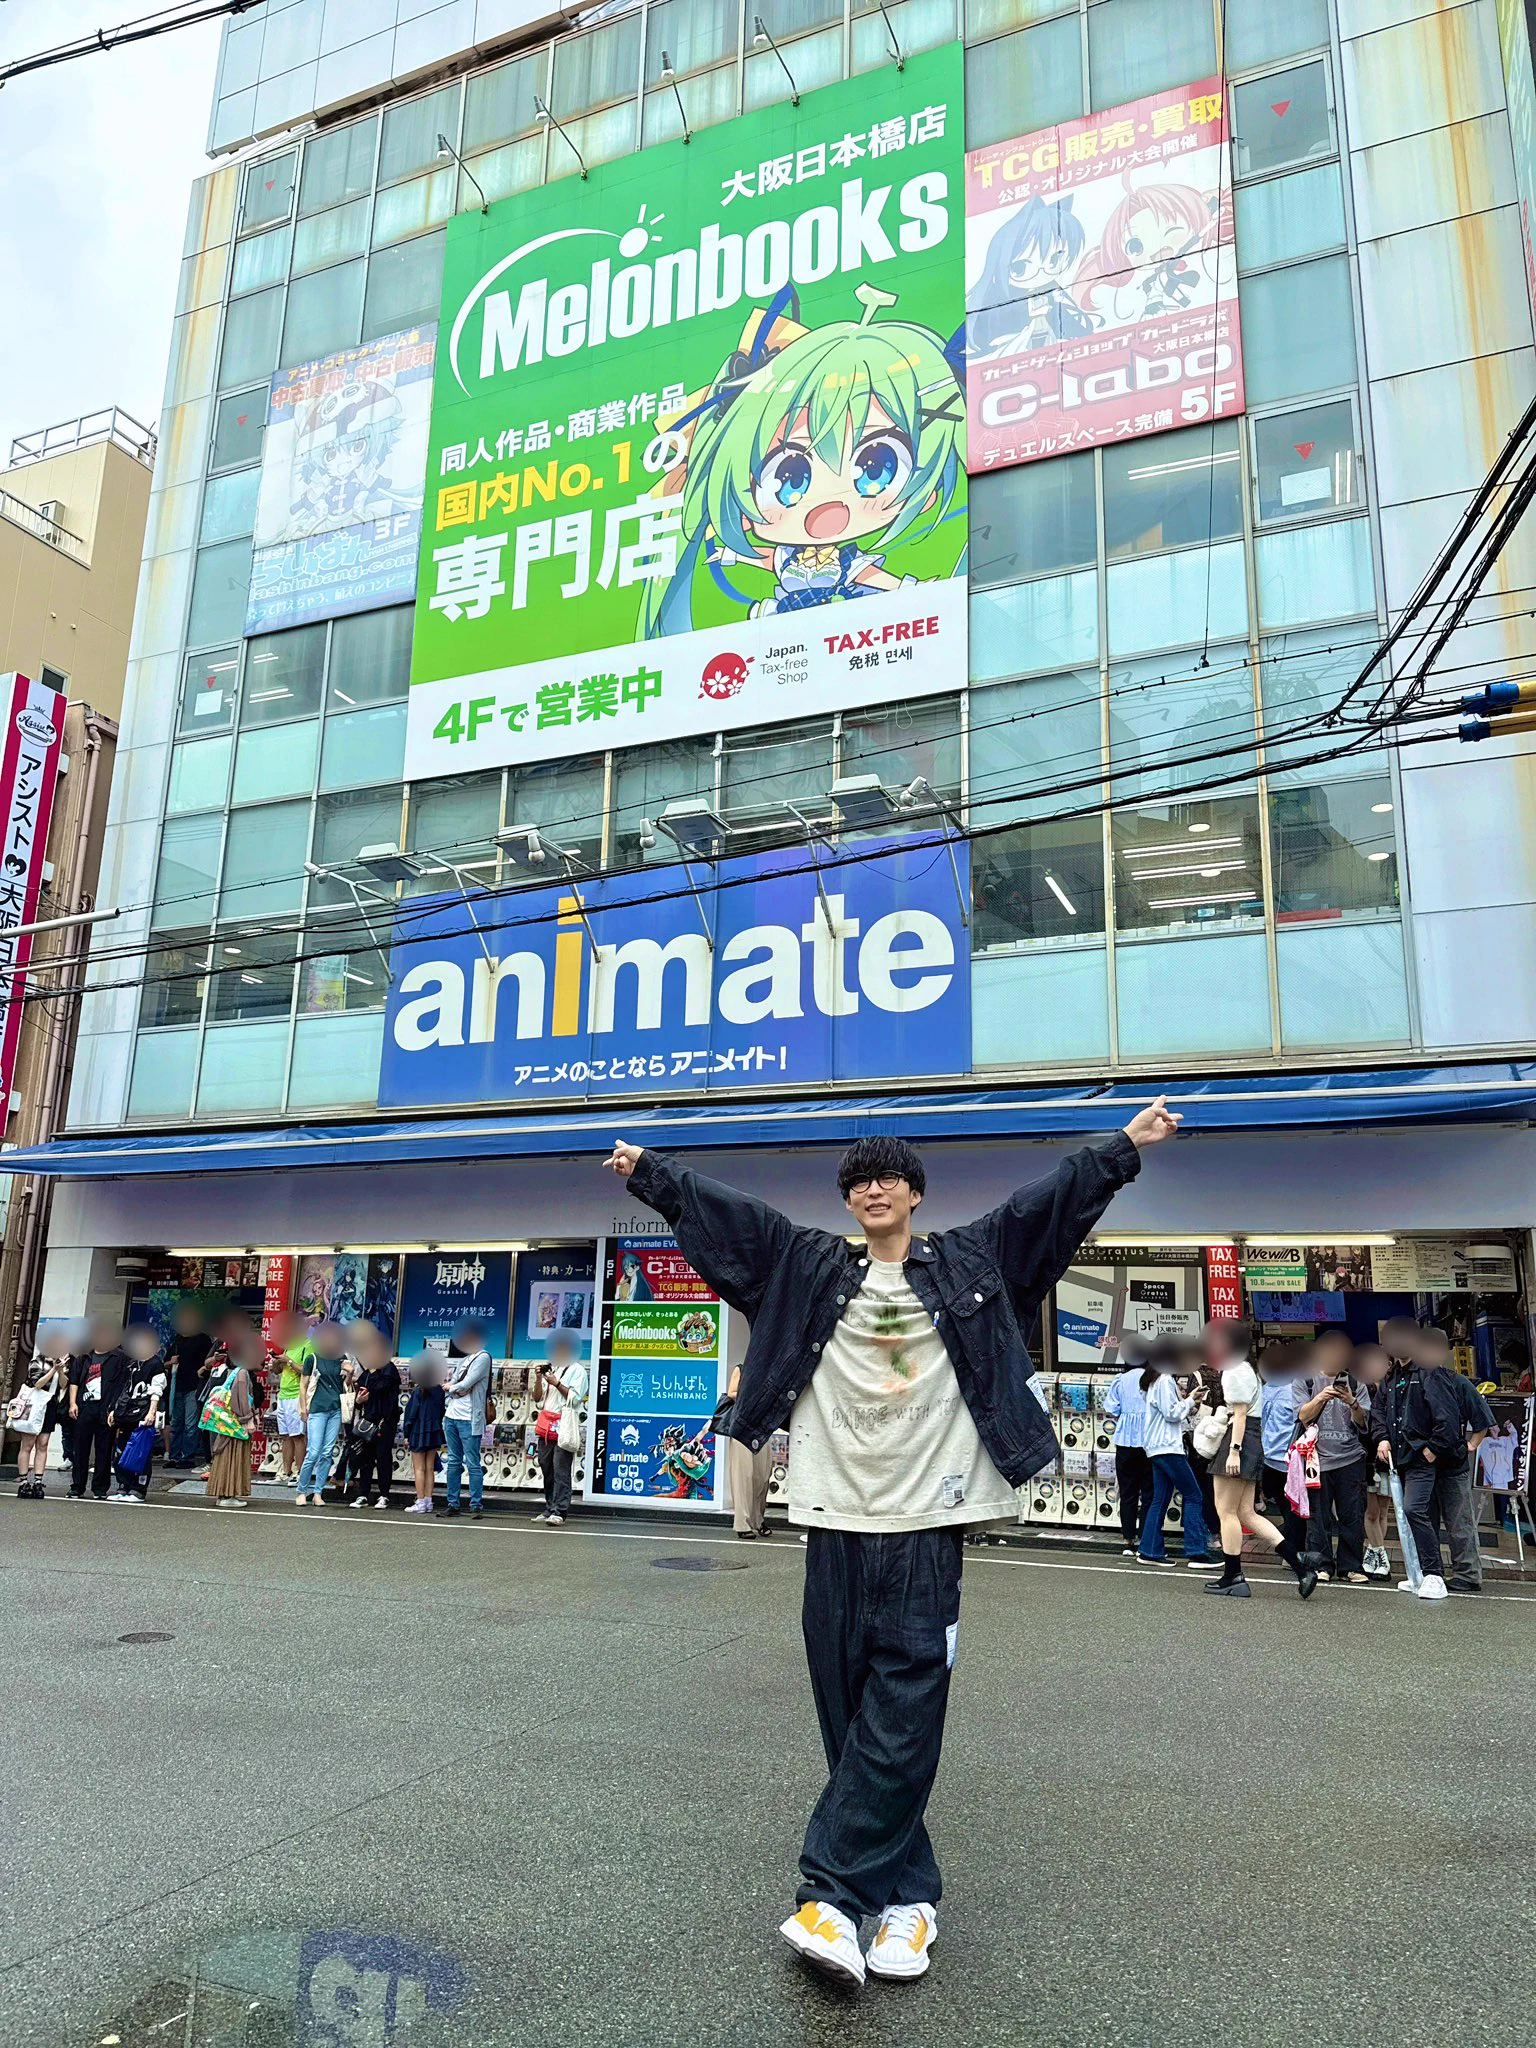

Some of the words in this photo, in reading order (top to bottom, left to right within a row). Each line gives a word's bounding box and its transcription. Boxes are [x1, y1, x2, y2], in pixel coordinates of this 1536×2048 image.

[974, 143, 1060, 189] TCG
[1064, 91, 1224, 165] 販売・買取
[720, 103, 948, 206] 大阪日本橋店
[998, 133, 1199, 206] 公認・オリジナル大会開催
[479, 171, 949, 379] Melonbooks
[982, 331, 1133, 382] カードゲームショップ
[1139, 307, 1230, 339] カードラボ
[982, 343, 1235, 427] C-labo
[439, 383, 687, 476] 同人作品・商業作品
[982, 408, 1173, 467] デュエルスペース完備
[1180, 381, 1237, 421] 5F
[374, 514, 411, 541] 3F
[428, 493, 685, 623] 専門店
[823, 616, 939, 655] TAX-FREE
[765, 643, 808, 659] Japan.
[849, 651, 880, 671] 免税
[885, 646, 913, 664] 면세
[760, 657, 808, 675] Tax-free
[777, 670, 809, 686] Shop
[433, 666, 663, 745] 4Fで営業中
[11, 753, 40, 852] アシスト
[393, 894, 955, 1051] animate
[632, 1240, 662, 1248] animate
[1210, 1248, 1233, 1262] TAX
[1209, 1265, 1236, 1279] FREE
[658, 1283, 673, 1291] TCG
[1212, 1287, 1235, 1301] TAX
[1211, 1304, 1239, 1319] FREE
[603, 1320, 611, 1339] 4F
[618, 1325, 677, 1340] Melonbooks
[1071, 1323, 1100, 1331] animate
[1140, 1320, 1155, 1331] 3F
[600, 1375, 608, 1395] 3F
[652, 1375, 708, 1391] らしんばん
[651, 1392, 708, 1400] LASHINBANG
[609, 1449, 649, 1463] animate
